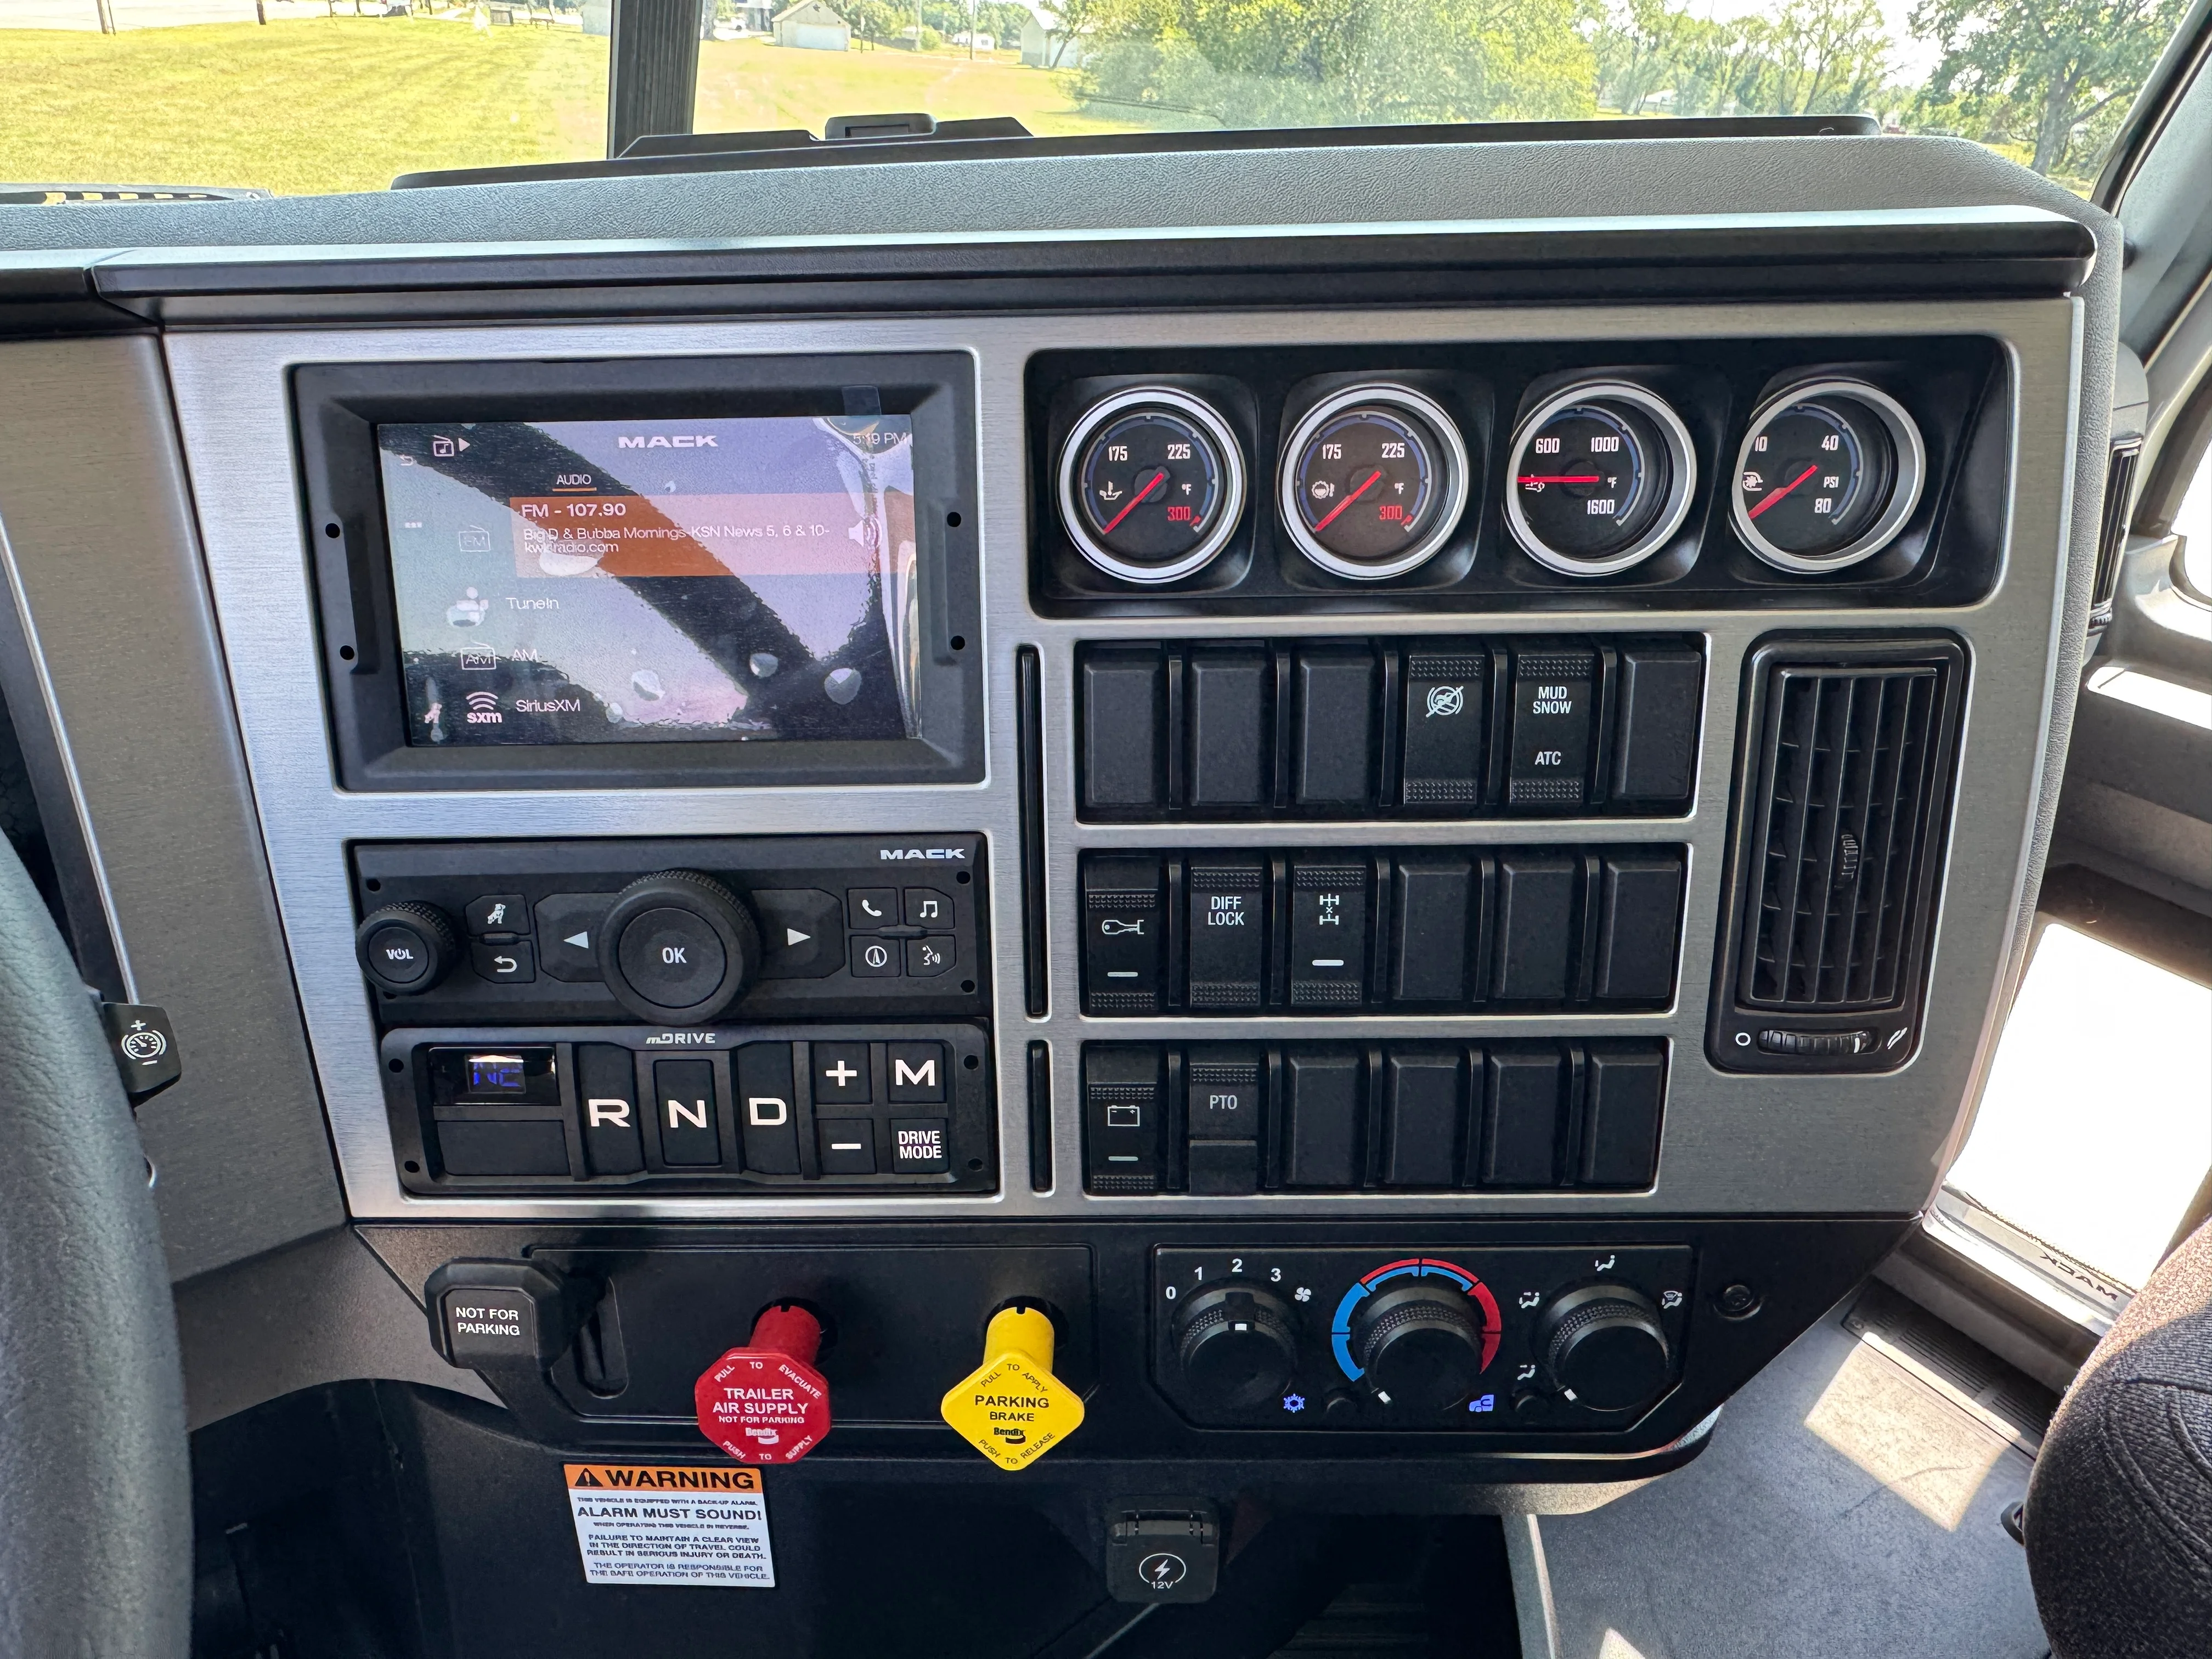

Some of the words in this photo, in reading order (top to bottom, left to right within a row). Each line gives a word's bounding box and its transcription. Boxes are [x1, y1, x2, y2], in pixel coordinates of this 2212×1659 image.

[618, 435, 718, 448] MACK
[884, 432, 907, 444] PM
[1590, 437, 1619, 452] 1000
[1821, 435, 1839, 450] 40
[1108, 445, 1128, 461] 175
[1167, 444, 1190, 460] 225
[1322, 444, 1342, 460] 175
[1381, 442, 1405, 458] 225
[1536, 438, 1560, 454] 600
[556, 474, 591, 485] AUDIO
[1824, 476, 1839, 488] PSI
[521, 504, 549, 517] FM
[566, 503, 627, 517] 107.90
[1379, 505, 1402, 521] 300
[1587, 499, 1615, 515] 1600
[1814, 498, 1832, 513] 80
[1167, 506, 1190, 521] 300
[563, 528, 573, 539] &
[577, 527, 620, 540] Bubba
[724, 525, 763, 538] News
[766, 524, 778, 538] 5,
[782, 524, 792, 537] 6
[795, 524, 806, 537] &
[505, 597, 560, 610] TuneIn
[465, 654, 492, 665] AM
[511, 648, 539, 662] AM
[1537, 686, 1567, 699] MUD
[515, 698, 581, 713] SiriusXM
[1532, 700, 1572, 715] SNOW
[466, 712, 503, 724] sxm
[1534, 751, 1561, 765] ATC
[880, 848, 966, 860] MACK
[1210, 896, 1242, 911] DIFF
[1207, 911, 1245, 926] LOCK
[386, 948, 414, 961] VOL
[662, 946, 687, 965] OK
[645, 1032, 716, 1045] mDRIVE
[895, 1060, 935, 1086] M
[1209, 1094, 1238, 1110] PTO
[589, 1098, 630, 1128] R
[669, 1099, 707, 1129] N
[750, 1097, 787, 1126] D
[898, 1130, 940, 1146] DRIVE
[899, 1144, 943, 1160] MODE
[1232, 1259, 1243, 1272] 2
[1194, 1267, 1203, 1280] 1
[1270, 1268, 1282, 1282] 3
[1166, 1286, 1177, 1300] 0
[455, 1307, 486, 1319] NOT
[489, 1308, 519, 1321] FOR
[457, 1322, 520, 1336] PARKING
[714, 1364, 735, 1383] PULL
[749, 1361, 764, 1369] TO
[778, 1364, 822, 1400] EVACUATE
[980, 1372, 1002, 1387] PULL
[1022, 1372, 1048, 1393] APPLY
[723, 1387, 794, 1400] TRAILER
[713, 1402, 740, 1414] AIR
[744, 1402, 809, 1414] SUPPLY
[975, 1395, 1049, 1408] PARKING
[741, 1415, 760, 1424] FOR
[990, 1411, 1035, 1422] BRAKE
[745, 1427, 778, 1436] Bendix
[994, 1427, 1025, 1436] Bendix
[722, 1440, 746, 1459] PUSH
[785, 1435, 813, 1459] SUPPLY
[979, 1439, 1001, 1458] PUSH
[1020, 1432, 1056, 1459] RELEASE
[605, 1469, 754, 1489] WARNING
[578, 1506, 638, 1518] ALARM
[642, 1508, 691, 1519] MUST
[695, 1509, 762, 1521] SOUND!
[1151, 1581, 1174, 1590] 12V
